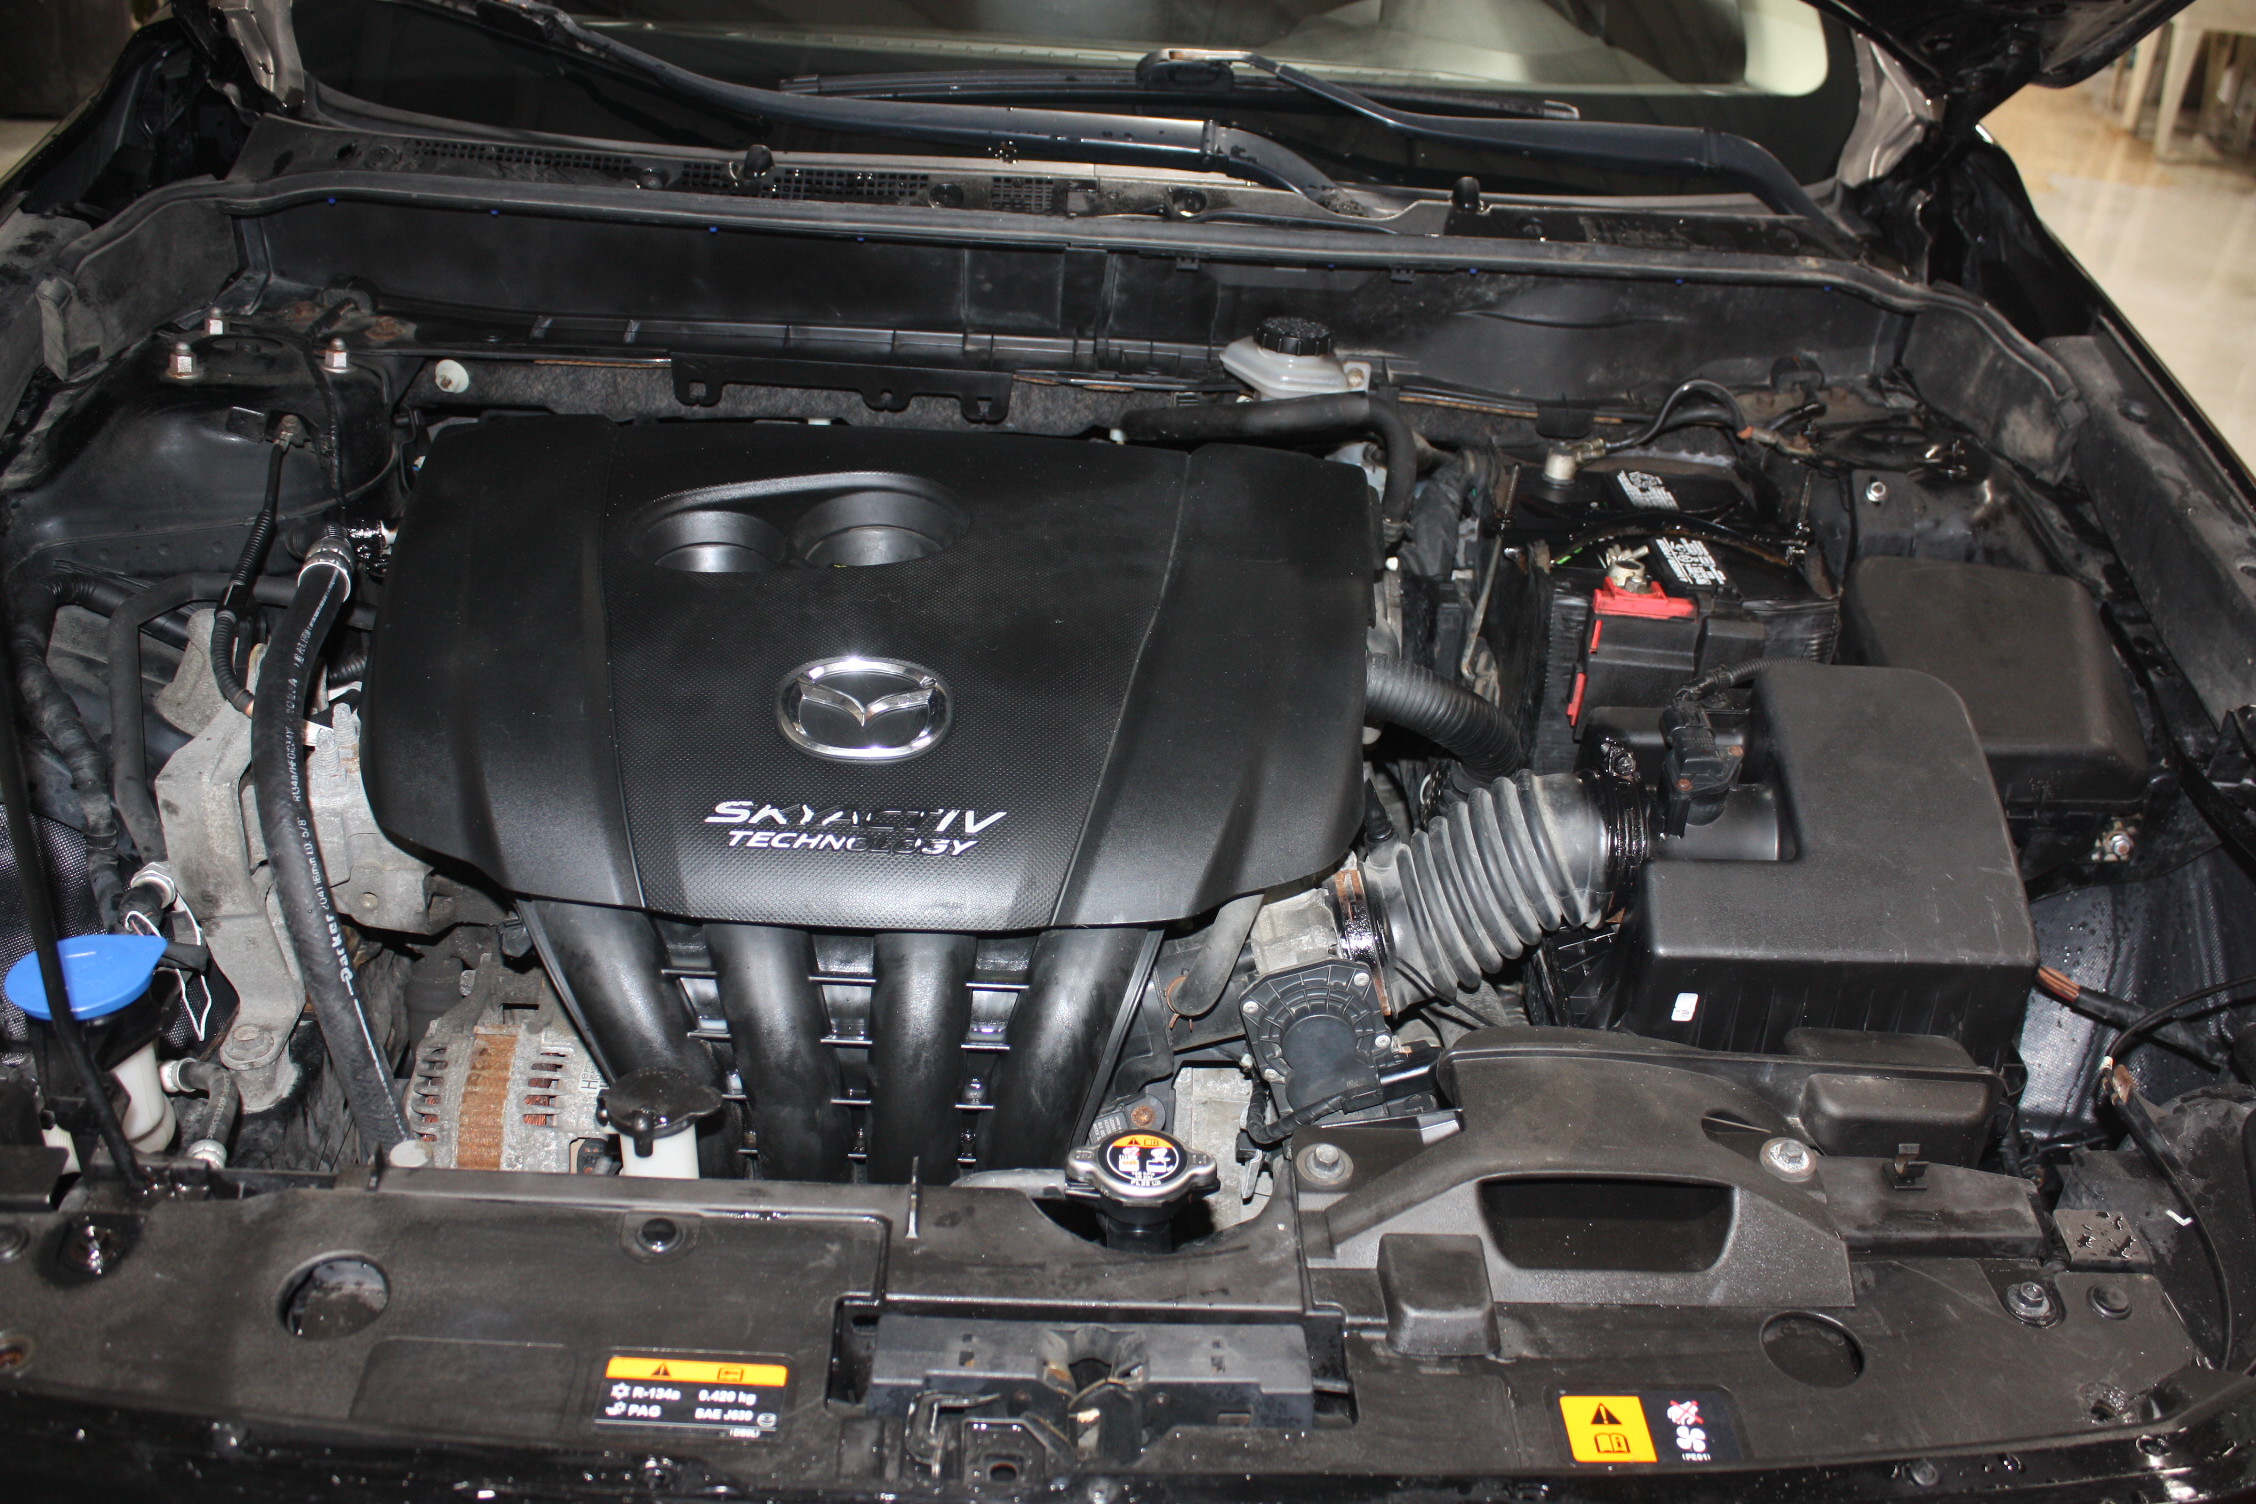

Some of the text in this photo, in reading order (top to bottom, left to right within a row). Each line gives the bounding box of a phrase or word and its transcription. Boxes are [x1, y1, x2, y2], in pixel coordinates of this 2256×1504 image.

[728, 830, 979, 857] TECHNOLOGY
[308, 857, 322, 885] 16mm
[632, 1386, 681, 1401] R-134a
[738, 1391, 757, 1406] kg
[628, 1403, 662, 1418] PAG
